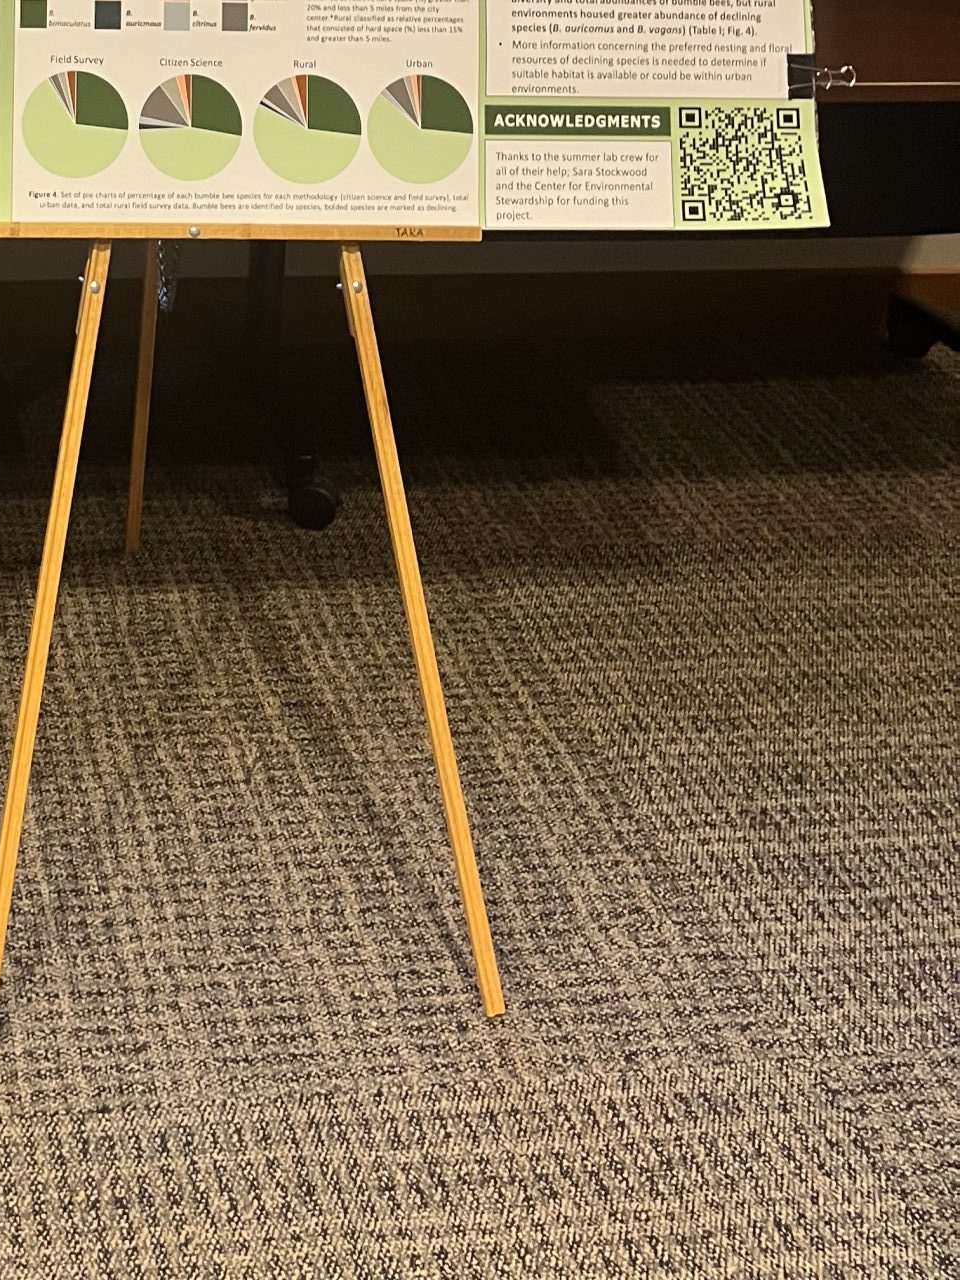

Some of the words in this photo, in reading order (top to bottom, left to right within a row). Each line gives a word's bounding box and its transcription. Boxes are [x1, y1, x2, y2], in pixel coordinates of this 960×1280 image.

[50, 54, 71, 64] Field
[73, 55, 104, 65] Survey
[159, 57, 188, 66] Citizen
[190, 58, 223, 67] Science
[293, 59, 316, 68] Rural
[405, 58, 433, 68] Urban
[493, 113, 660, 128] ACKNOWLEDGMENTS
[495, 180, 513, 190] and
[516, 180, 532, 191] the
[534, 180, 566, 191] Center
[568, 180, 582, 191] for
[584, 181, 653, 191] Environmental
